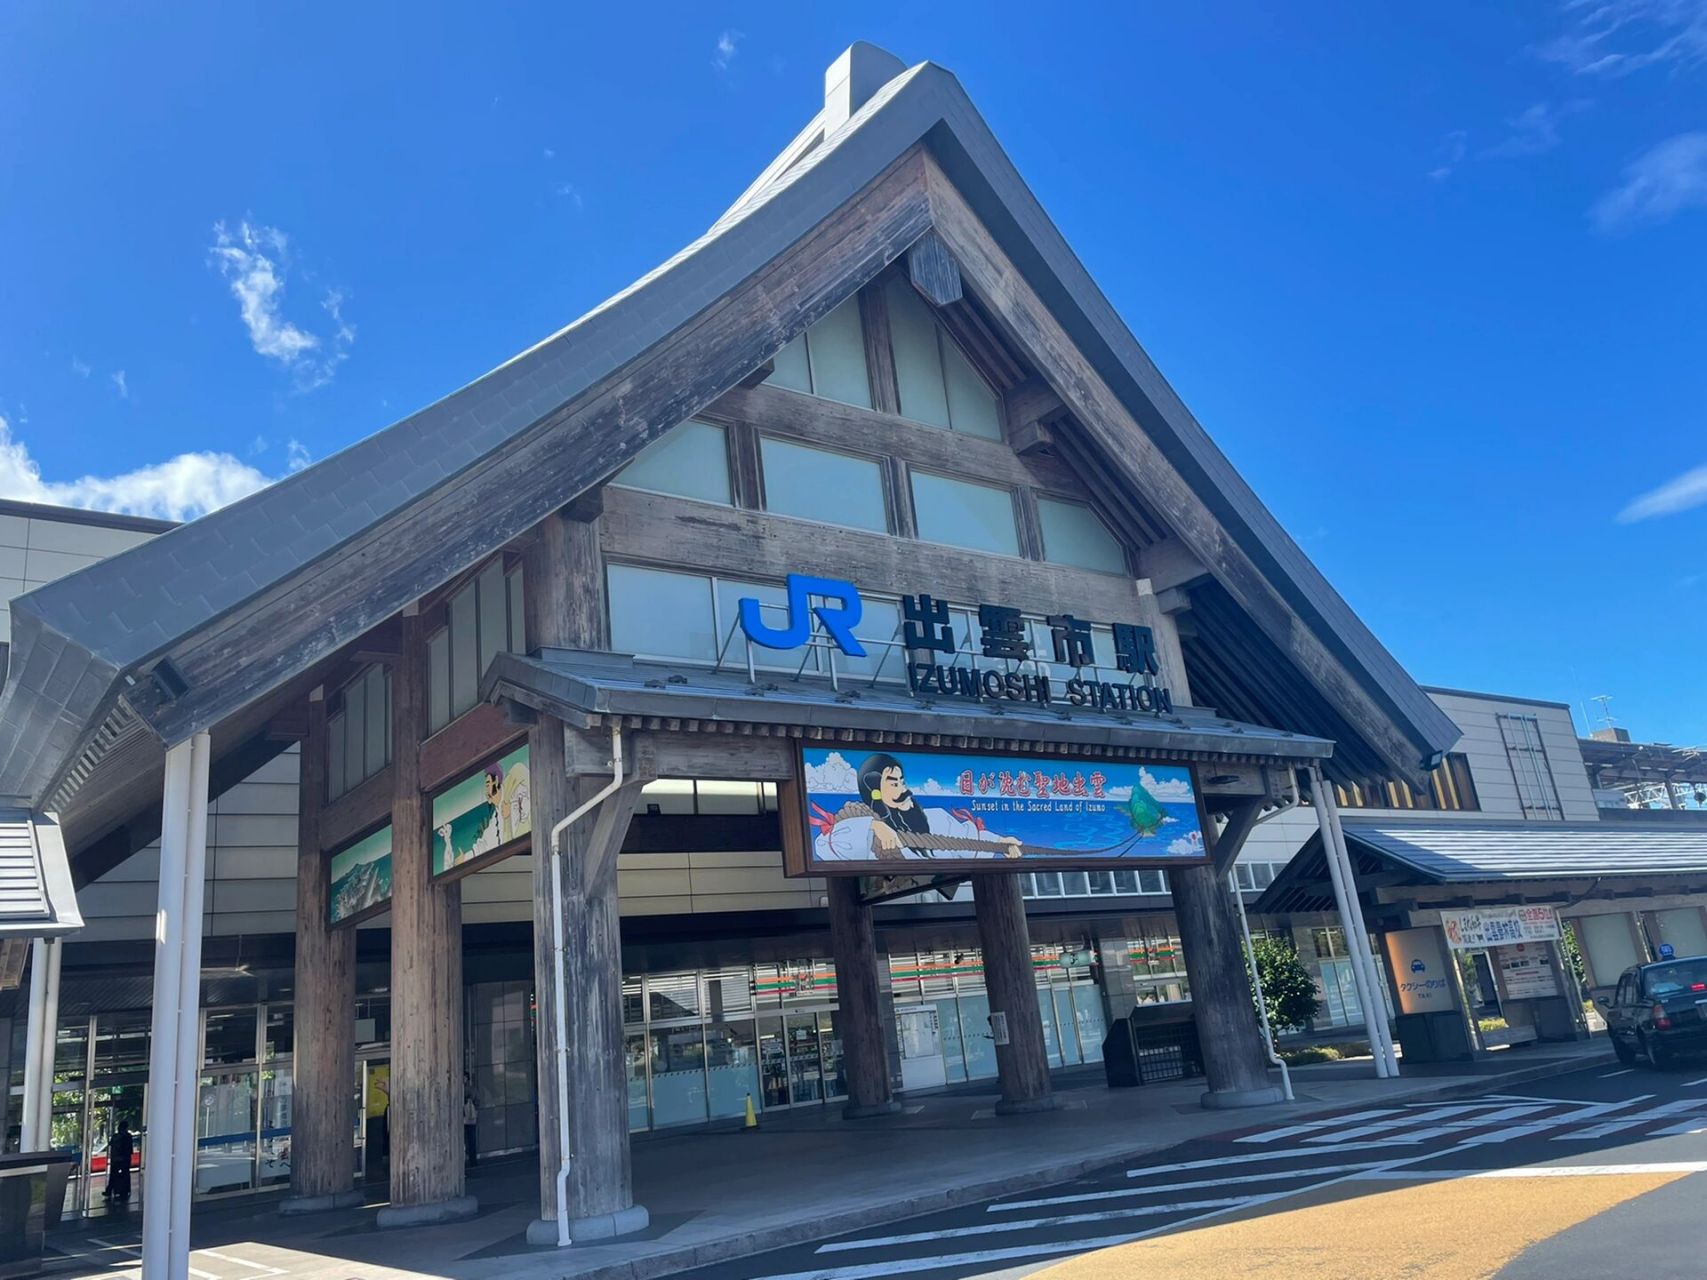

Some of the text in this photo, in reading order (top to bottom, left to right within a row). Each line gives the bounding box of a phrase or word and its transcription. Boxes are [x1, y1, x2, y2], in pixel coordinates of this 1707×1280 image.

[739, 573, 867, 657] JR
[902, 594, 1159, 676] 出雲市駅
[908, 661, 1173, 715] IZUMOSHI STATION
[960, 769, 1106, 798] 日が沈む聖地出雲
[971, 800, 1106, 813] Sunset in the Sacred Land of Izumo
[1400, 978, 1446, 992] タクシーのりば
